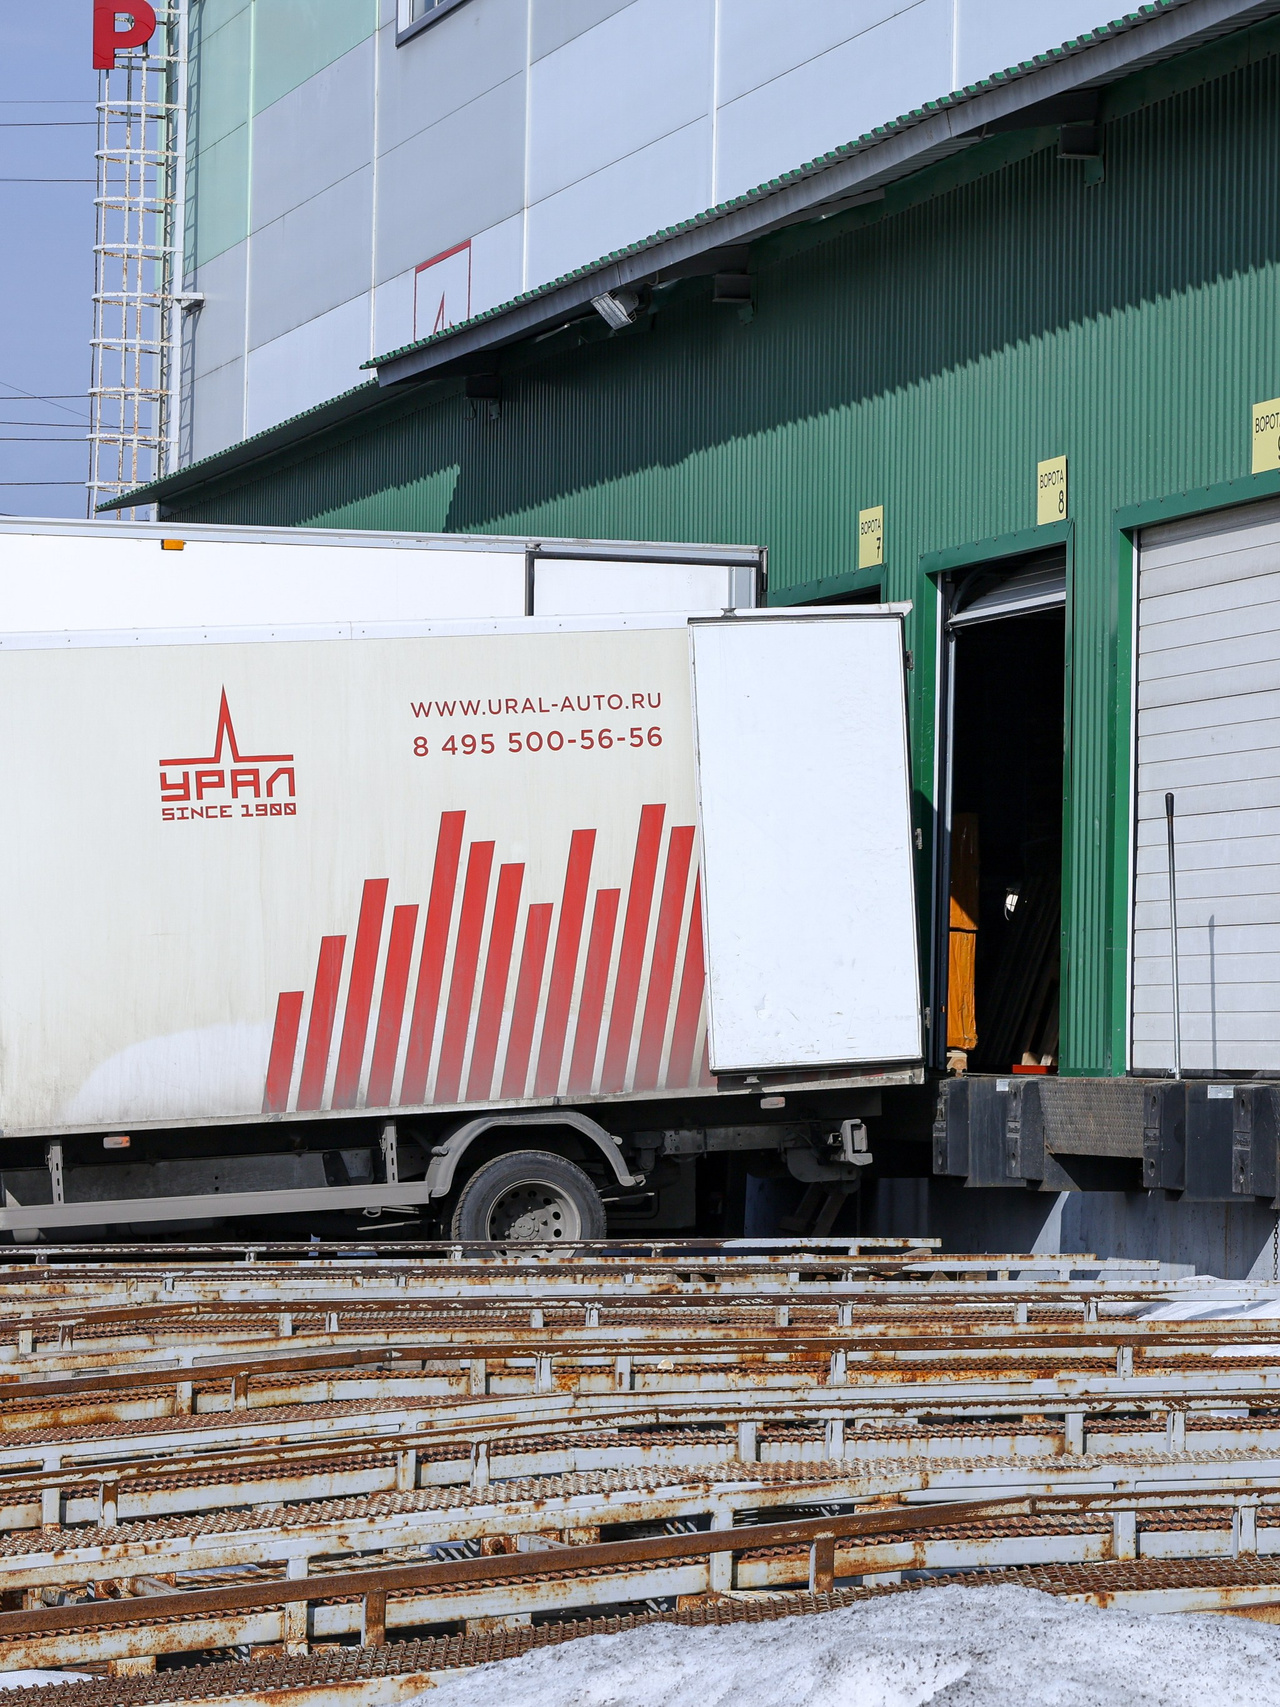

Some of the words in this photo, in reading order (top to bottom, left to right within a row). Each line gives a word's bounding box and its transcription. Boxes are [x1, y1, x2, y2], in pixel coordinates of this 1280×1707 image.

[1039, 469, 1065, 489] ВОРОТА
[1058, 489, 1065, 514] 8
[410, 692, 663, 718] WWW.URAL-AUTO.RU
[413, 736, 429, 757] 8
[441, 733, 496, 755] 495
[508, 726, 663, 753] 500-56-56
[160, 767, 296, 803] УРАЛ
[161, 804, 233, 821] SINCE
[240, 802, 297, 818] 1900
